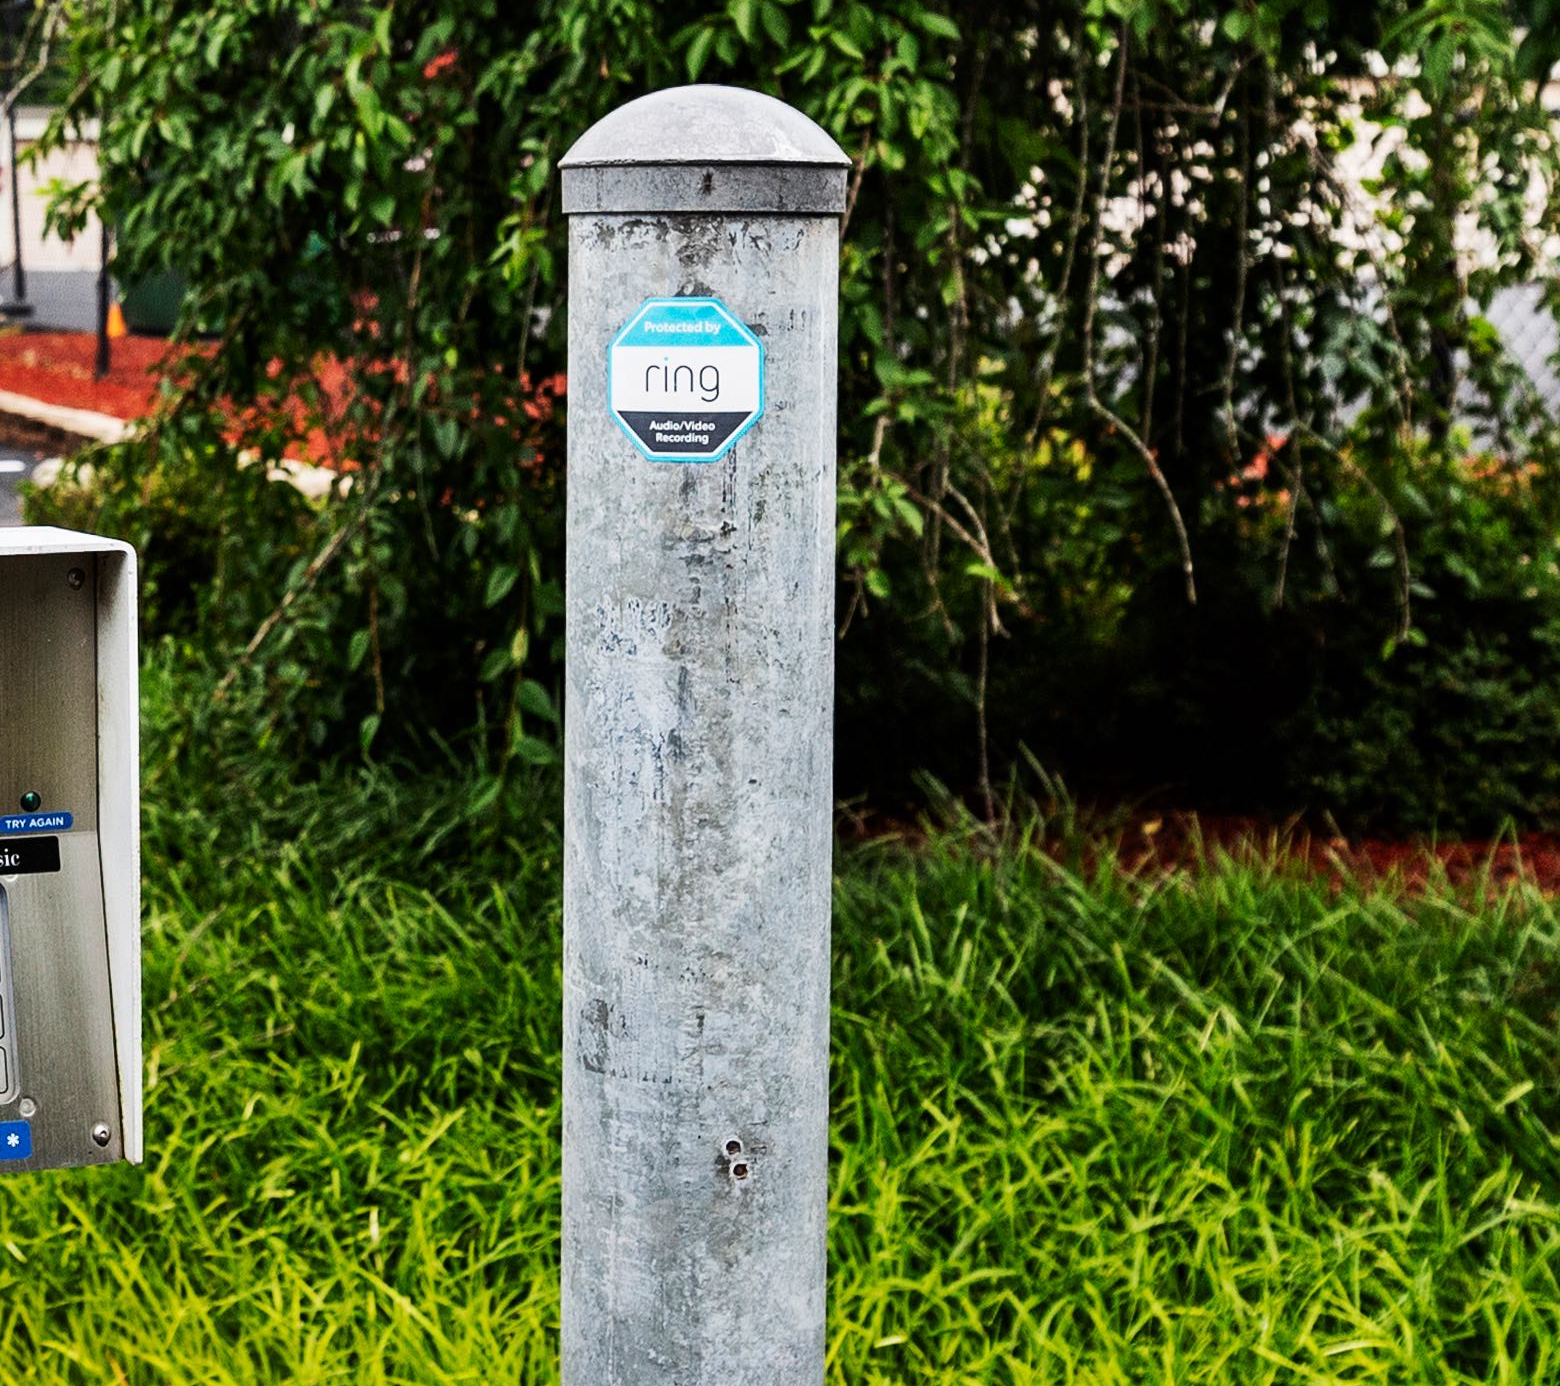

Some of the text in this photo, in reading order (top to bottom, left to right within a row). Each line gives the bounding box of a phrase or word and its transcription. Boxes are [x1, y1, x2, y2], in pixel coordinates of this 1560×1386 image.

[644, 322, 721, 335] Protected by
[644, 356, 720, 403] ring
[649, 420, 716, 432] Audio/Video
[655, 433, 710, 445] Recording
[4, 815, 65, 831] TRY AGAIN
